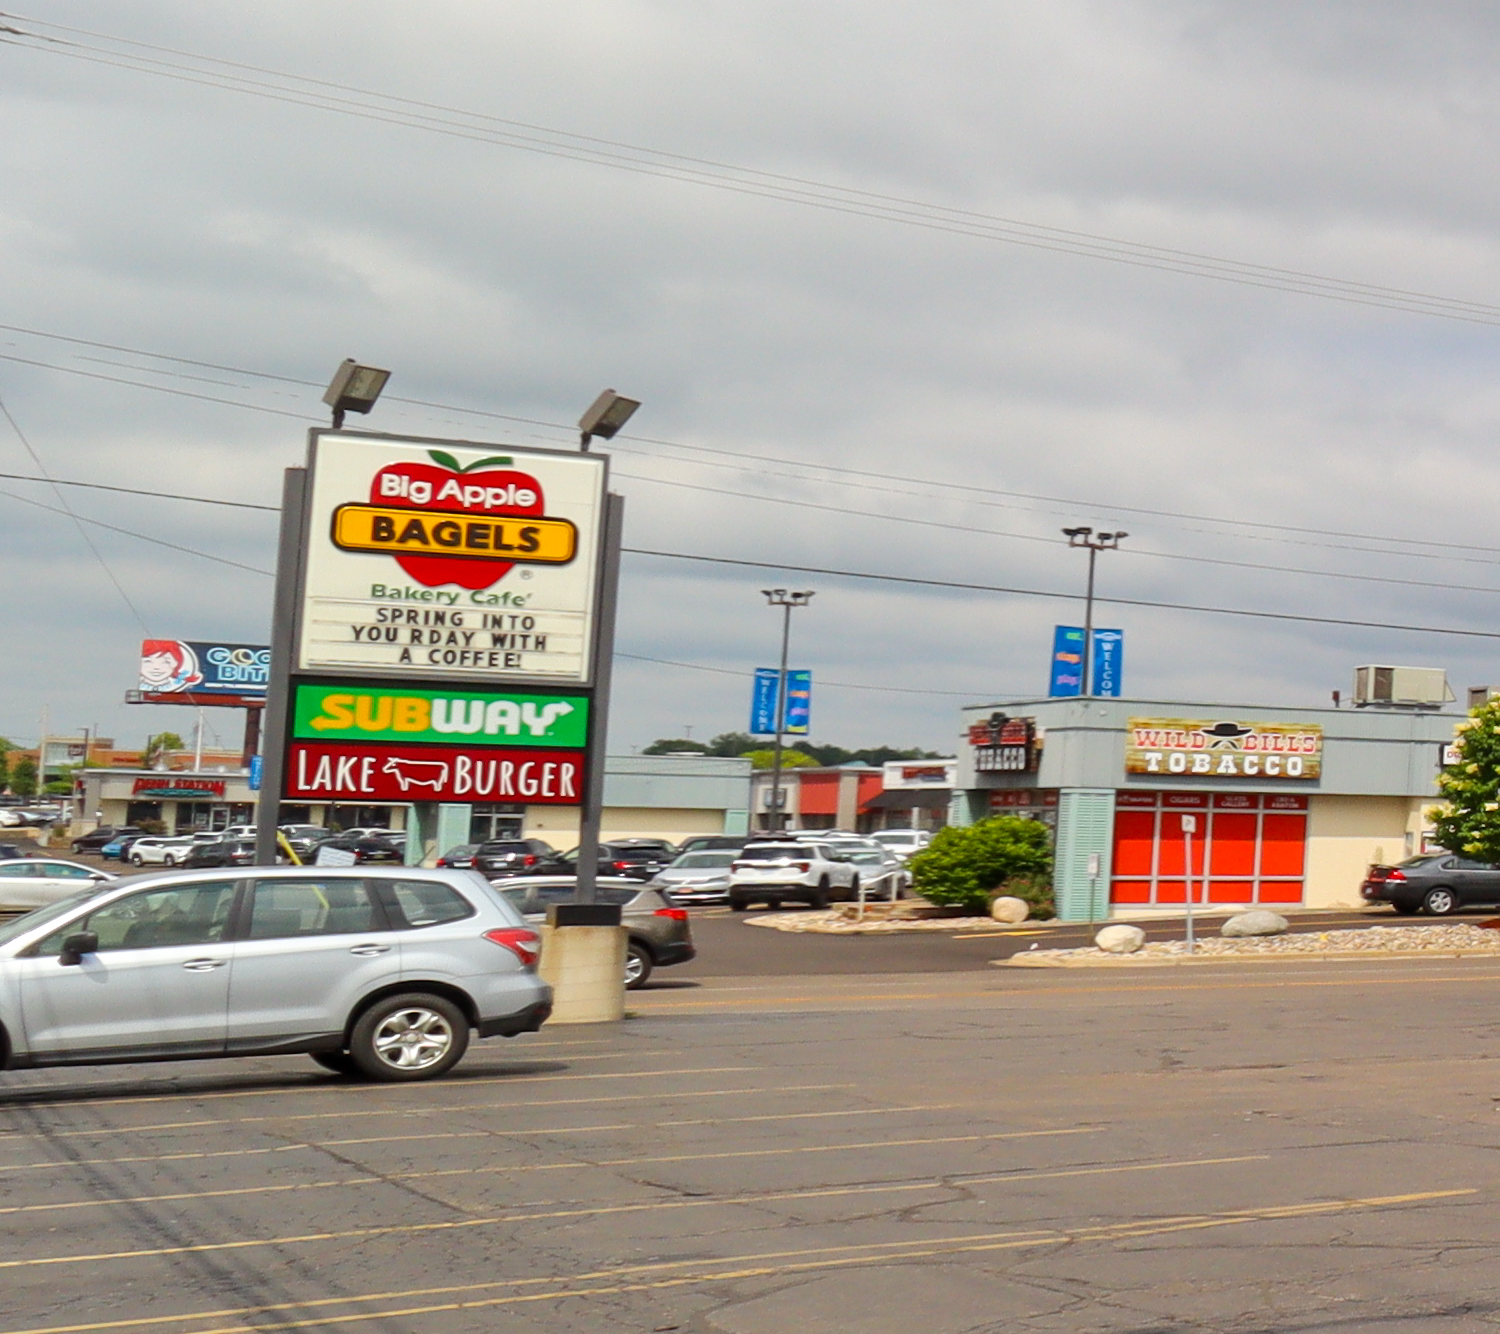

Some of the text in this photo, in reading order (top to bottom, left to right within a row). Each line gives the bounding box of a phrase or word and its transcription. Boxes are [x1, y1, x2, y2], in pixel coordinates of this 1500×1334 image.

[381, 474, 537, 509] Big Apple
[372, 517, 540, 553] BAGELS
[371, 584, 460, 606] Bakery
[377, 608, 535, 631] SPRING INTO
[491, 633, 547, 650] WITH
[400, 648, 522, 668] A COFFEE!
[310, 694, 575, 737] SUBWAY
[1134, 730, 1316, 753] WILD BILL'S
[297, 749, 376, 793] LAKE
[454, 755, 576, 798] BURGER
[1145, 752, 1304, 776] TOBACCO
